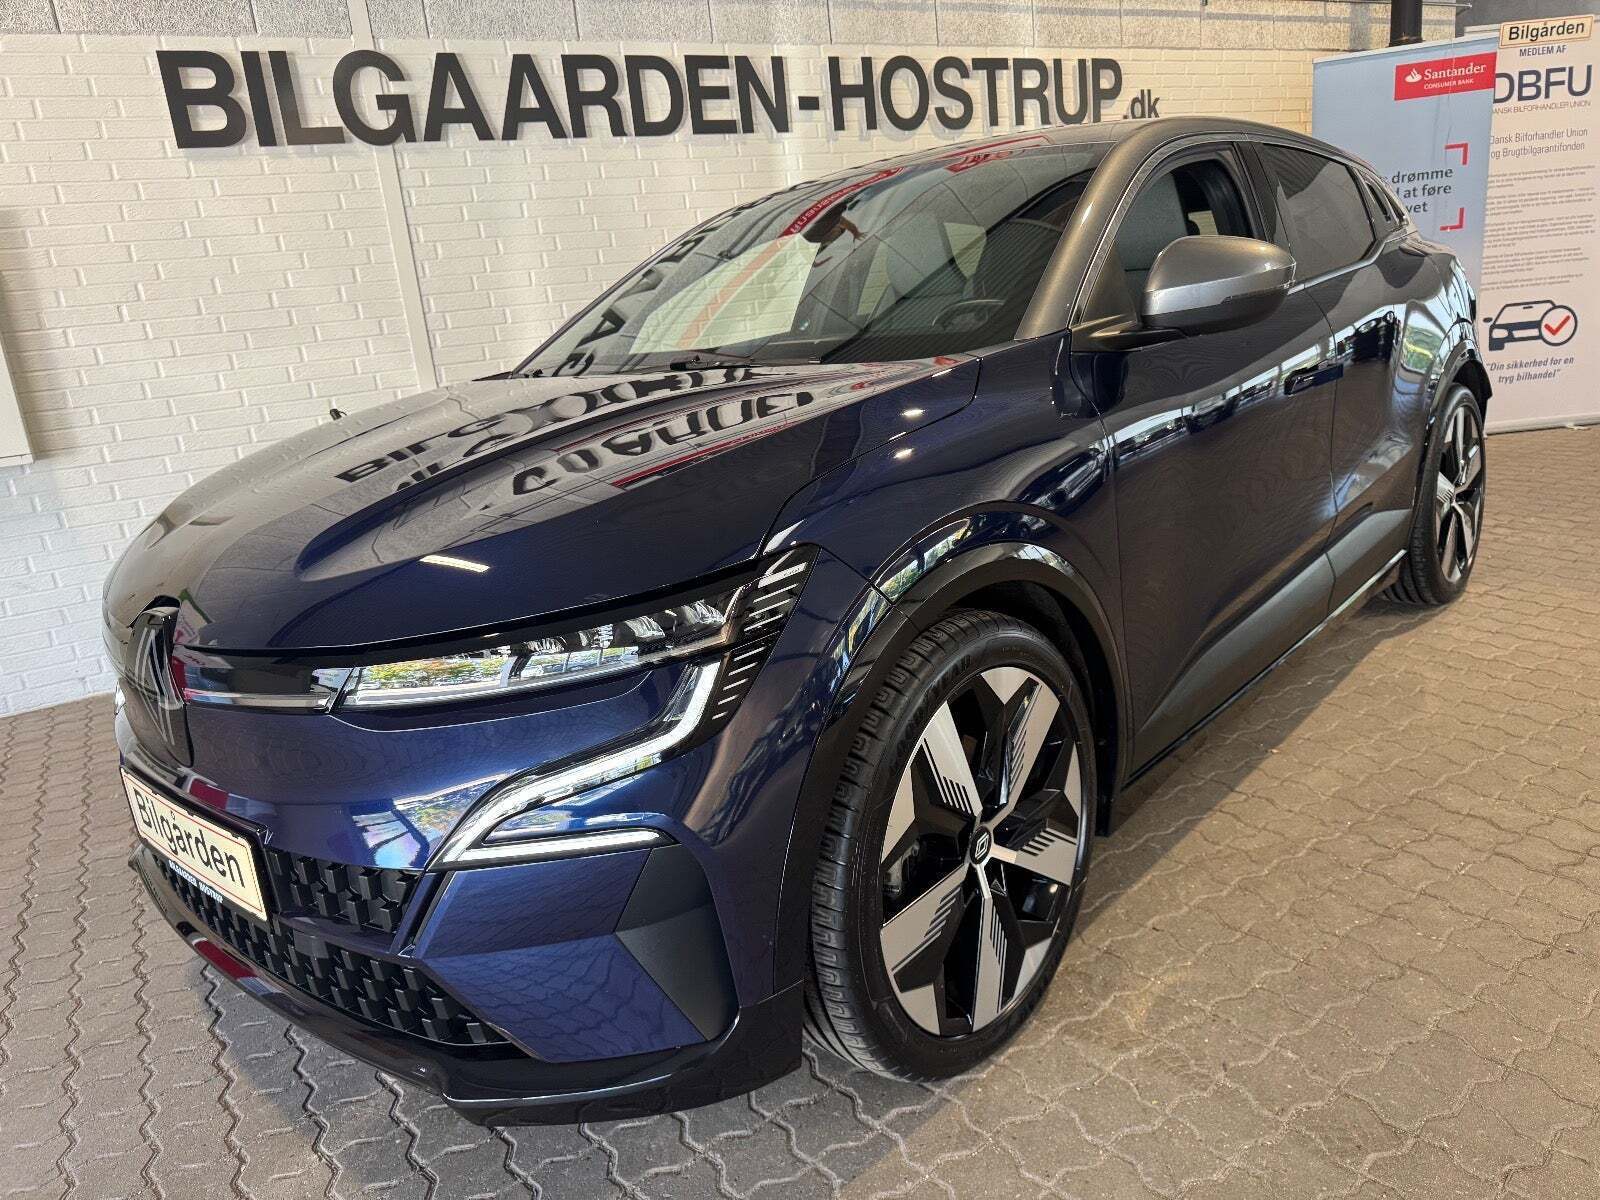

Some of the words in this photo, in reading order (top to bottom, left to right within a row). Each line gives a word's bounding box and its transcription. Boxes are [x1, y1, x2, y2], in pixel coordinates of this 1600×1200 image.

[1508, 20, 1585, 42] Bilgården
[1519, 46, 1555, 57] MEDLEM
[1556, 44, 1567, 54] AF
[1424, 62, 1487, 81] Santander
[1424, 80, 1457, 90] CONSUMER
[1458, 78, 1475, 87] BANK
[1493, 64, 1593, 104] DBFU
[1492, 106, 1513, 114] ANSK
[1515, 129, 1564, 143] Bilforhandler
[1566, 127, 1588, 138] Union
[1490, 150, 1501, 160] og
[1391, 168, 1454, 184] drømme
[1403, 186, 1419, 198] at
[1422, 183, 1452, 196] føre
[1405, 201, 1429, 214] vet
[1506, 357, 1548, 370] sikkerhed
[1550, 356, 1562, 366] for
[1563, 356, 1575, 365] en
[1498, 374, 1515, 385] tryg
[133, 786, 246, 889] Bilgården
